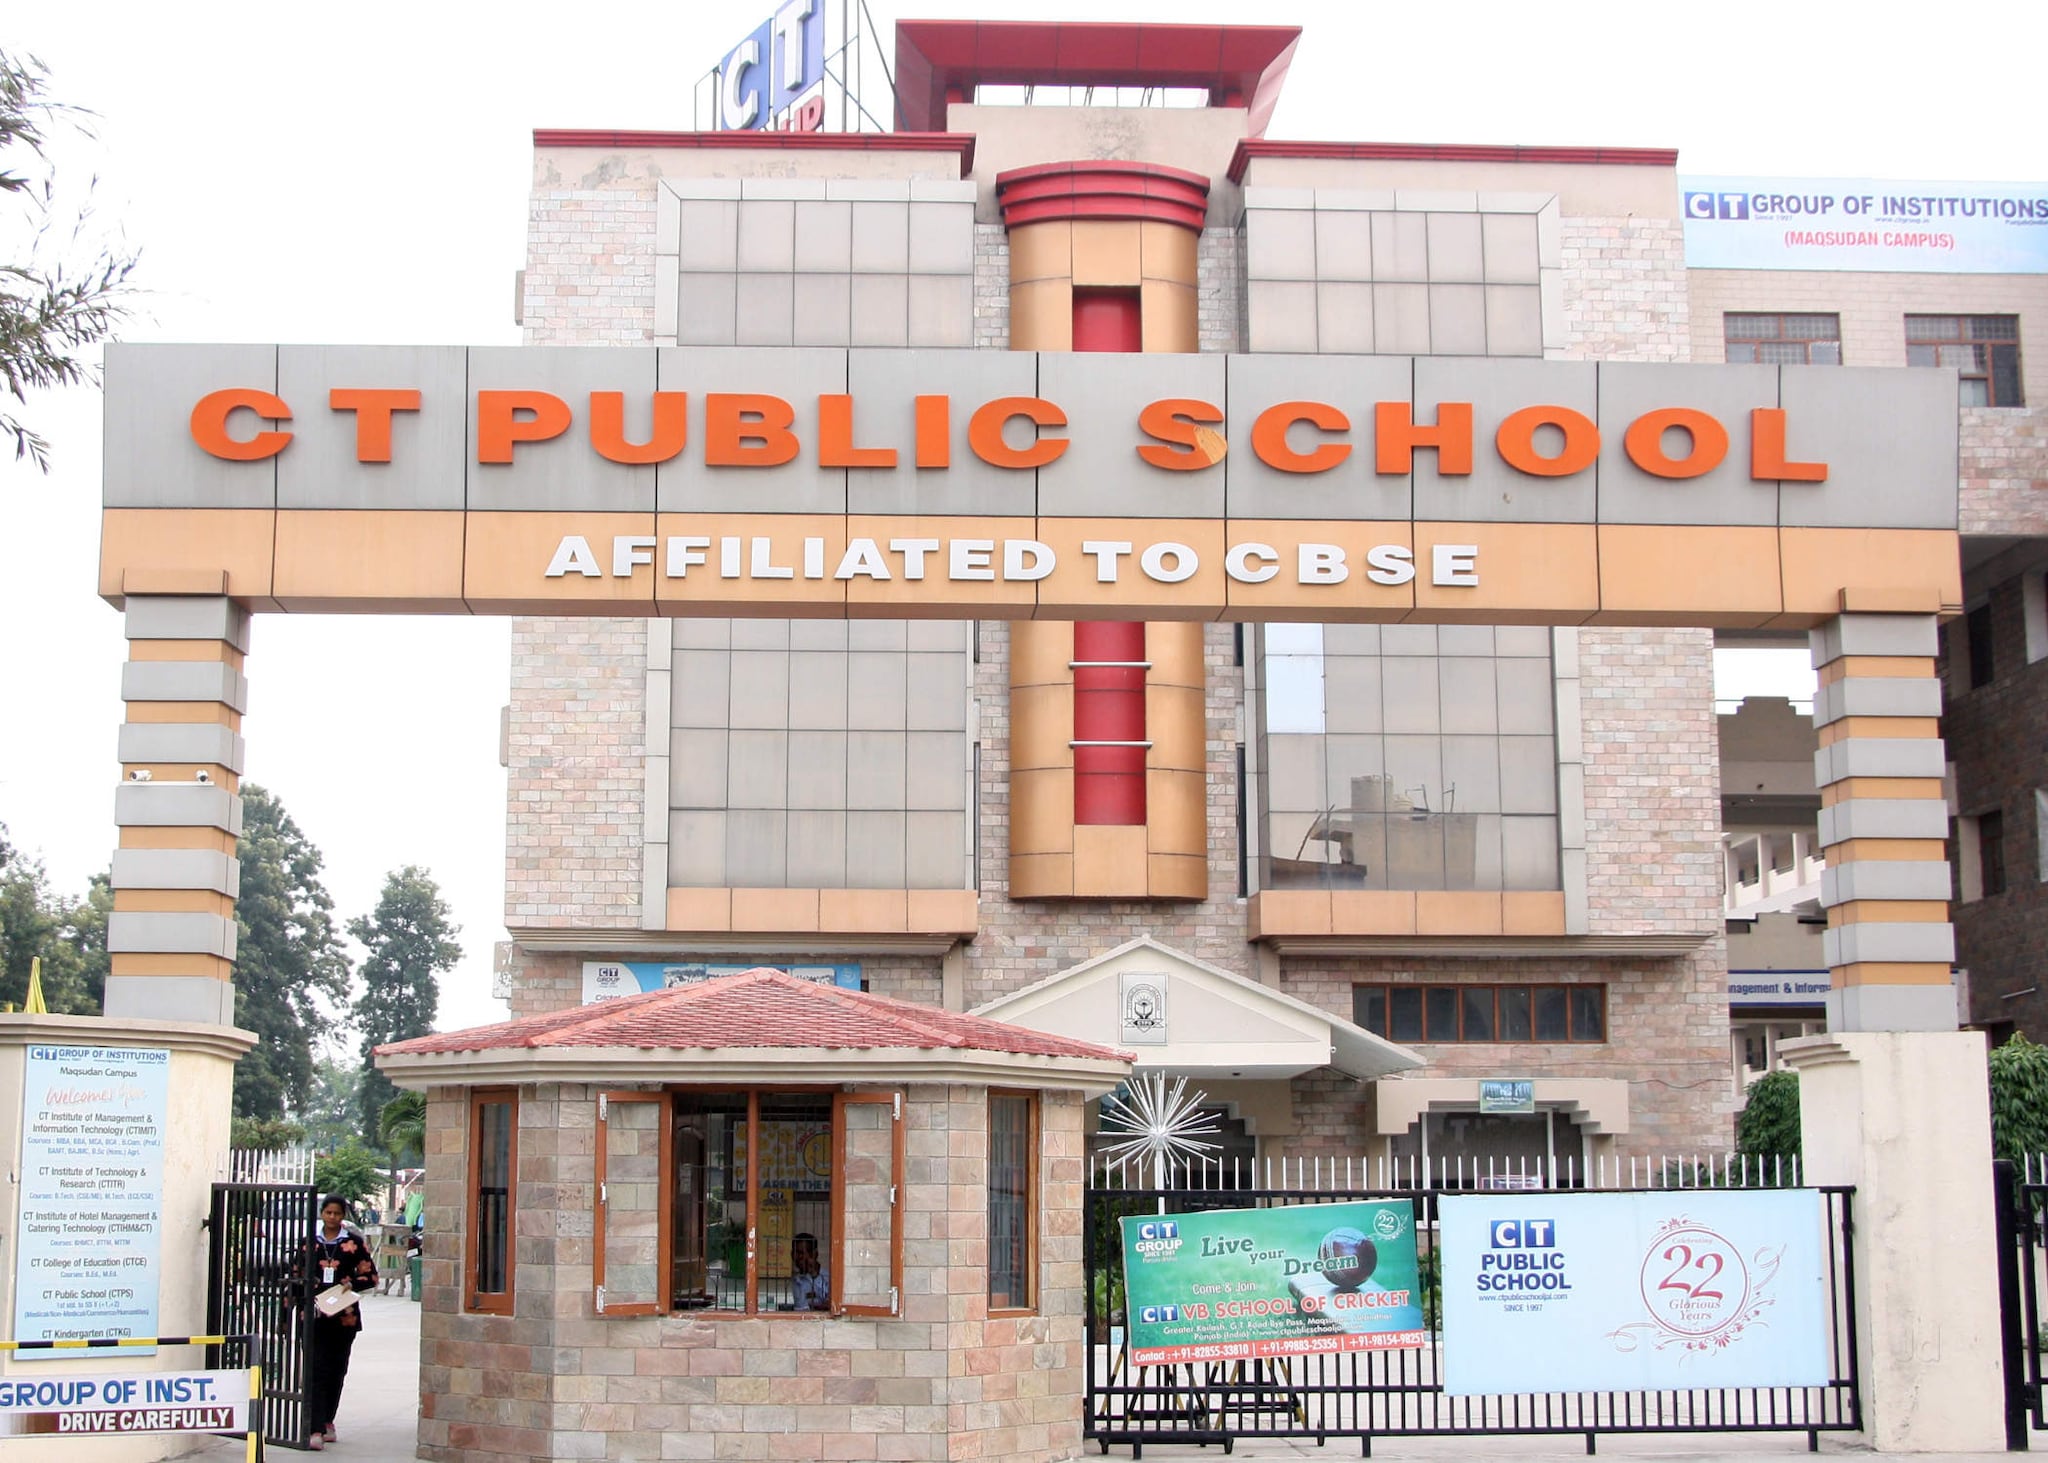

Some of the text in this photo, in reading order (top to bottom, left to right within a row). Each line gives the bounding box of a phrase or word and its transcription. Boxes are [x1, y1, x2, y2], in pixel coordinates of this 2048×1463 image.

[1687, 193, 2048, 219] CT GROUP OF INSTITUTIONS
[1784, 231, 1955, 250] (MAQSUDAN CAMPUS)
[478, 390, 1070, 469] PUBLIC
[1135, 397, 1829, 482] SCHOOL
[545, 535, 1480, 587] AFFILIATED TO CBSE
[600, 968, 618, 976] CT
[1783, 982, 1792, 993] &
[32, 1047, 167, 1060] CT GROUP OF INSTITUTIONS
[59, 1067, 138, 1078] Maqsudan Campus
[39, 1112, 49, 1121] CT
[51, 1112, 82, 1121] Institute
[85, 1113, 93, 1121] of
[95, 1114, 145, 1124] Management
[33, 1124, 78, 1133] Information
[80, 1125, 124, 1136] Technology
[39, 1167, 146, 1178] CT Institute of Technology &
[60, 1180, 126, 1189] Research (CTITR)
[23, 1212, 158, 1222] CT Institute of Hotel Management &
[28, 1223, 153, 1234] Catering Technology (CTIHM&CT)
[1140, 1221, 1177, 1240] CT
[1494, 1220, 1552, 1247] CT
[1135, 1239, 1183, 1252] GROUP
[1201, 1236, 1254, 1257] Live
[1672, 1237, 1713, 1245] Celebrating
[30, 1257, 148, 1269] CT College of Education (CTCE)
[1249, 1250, 1285, 1264] your
[1481, 1252, 1565, 1271] PUBLIC
[1284, 1255, 1359, 1276] Dream
[1658, 1245, 1723, 1299] 22
[1476, 1272, 1572, 1291] SCHOOL
[42, 1289, 134, 1299] CT Public School (CTPS)
[1192, 1282, 1257, 1295] Come & Join
[1142, 1290, 1410, 1321] CT VB SCHOOL OF CRICKET
[1503, 1304, 1524, 1312] SINCE
[1669, 1299, 1722, 1310] Glorious
[1680, 1310, 1712, 1320] Years
[1247, 1321, 1268, 1329] Road
[42, 1328, 132, 1339] CT Kindergarten (CTKG)
[1134, 1350, 1165, 1362] Contact
[0, 1377, 217, 1407] GROUP OF INST.
[58, 1408, 231, 1431] DRIVE CAREFULLY
